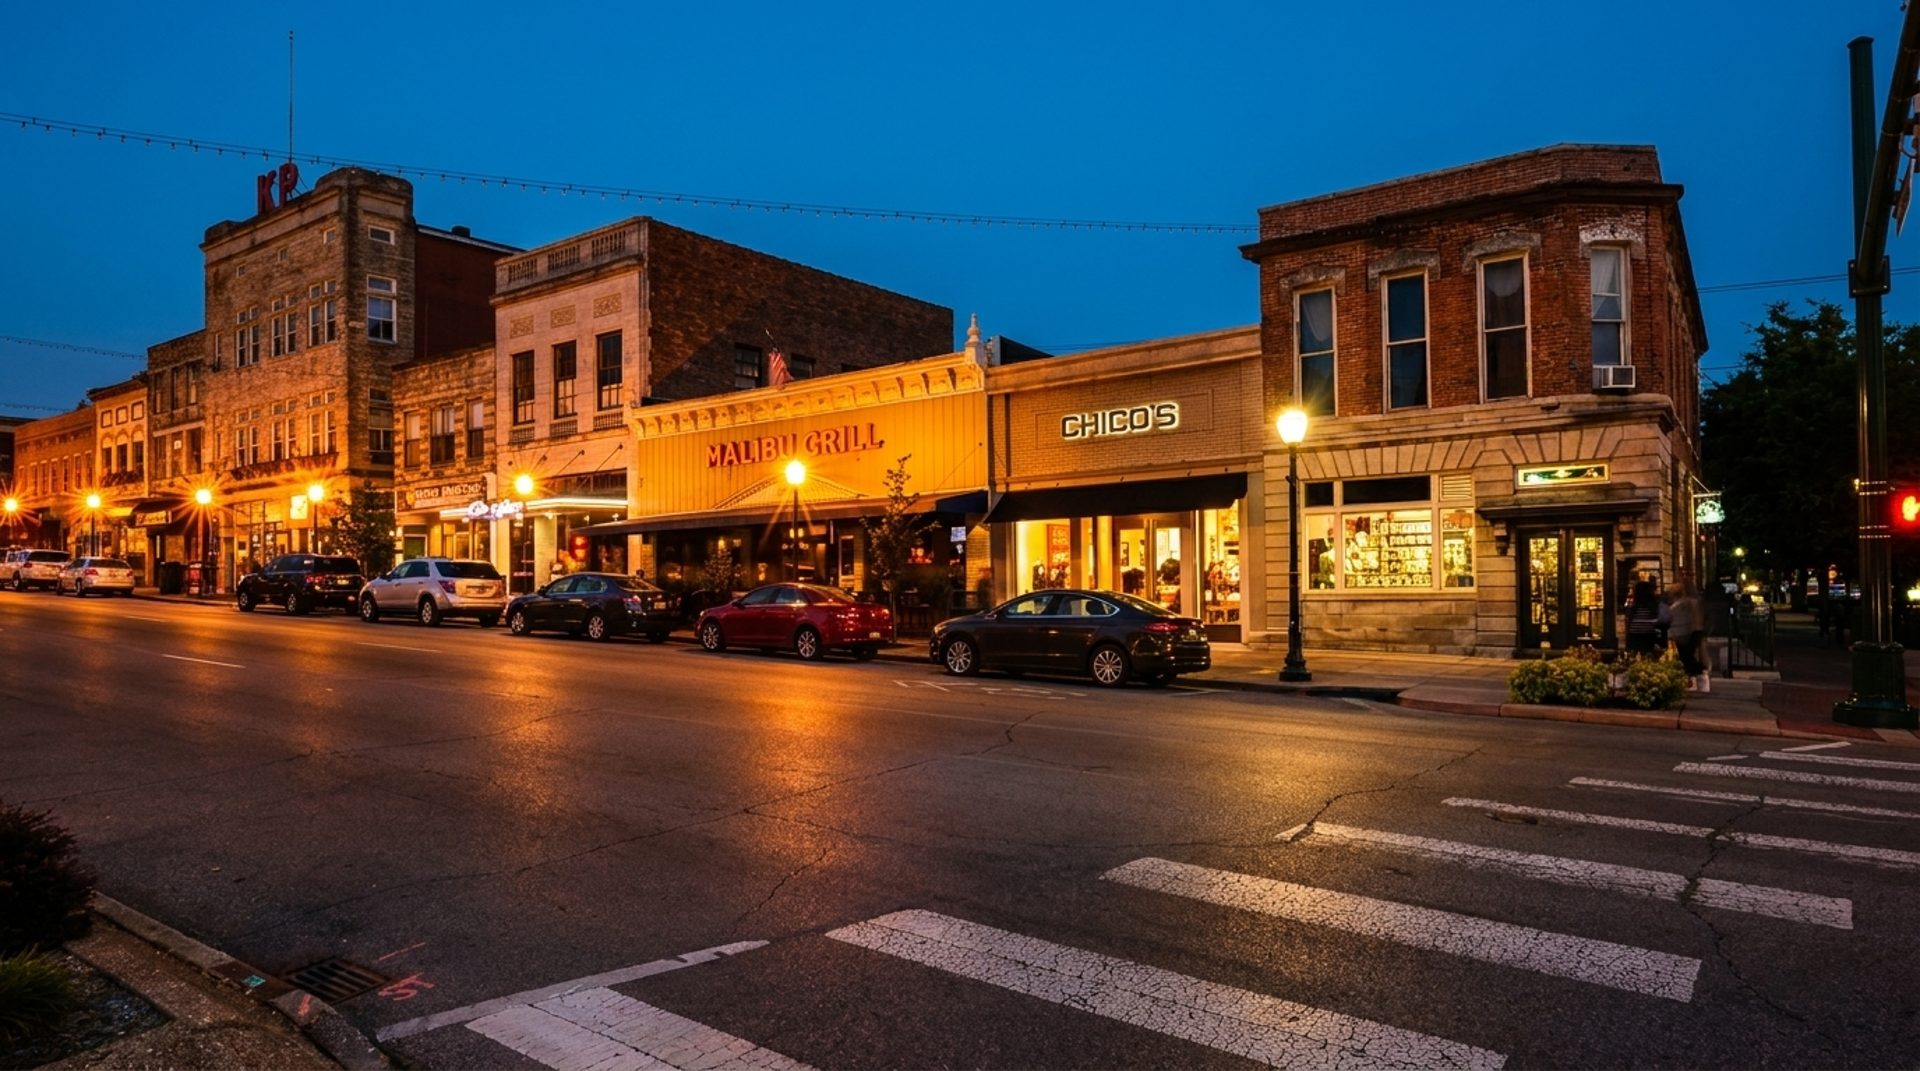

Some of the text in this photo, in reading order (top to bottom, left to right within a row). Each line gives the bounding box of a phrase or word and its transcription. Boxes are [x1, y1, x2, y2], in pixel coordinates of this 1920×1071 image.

[257, 162, 298, 214] KP
[1061, 403, 1177, 438] CHICO'S
[706, 423, 883, 468] MALIBU GRILL
